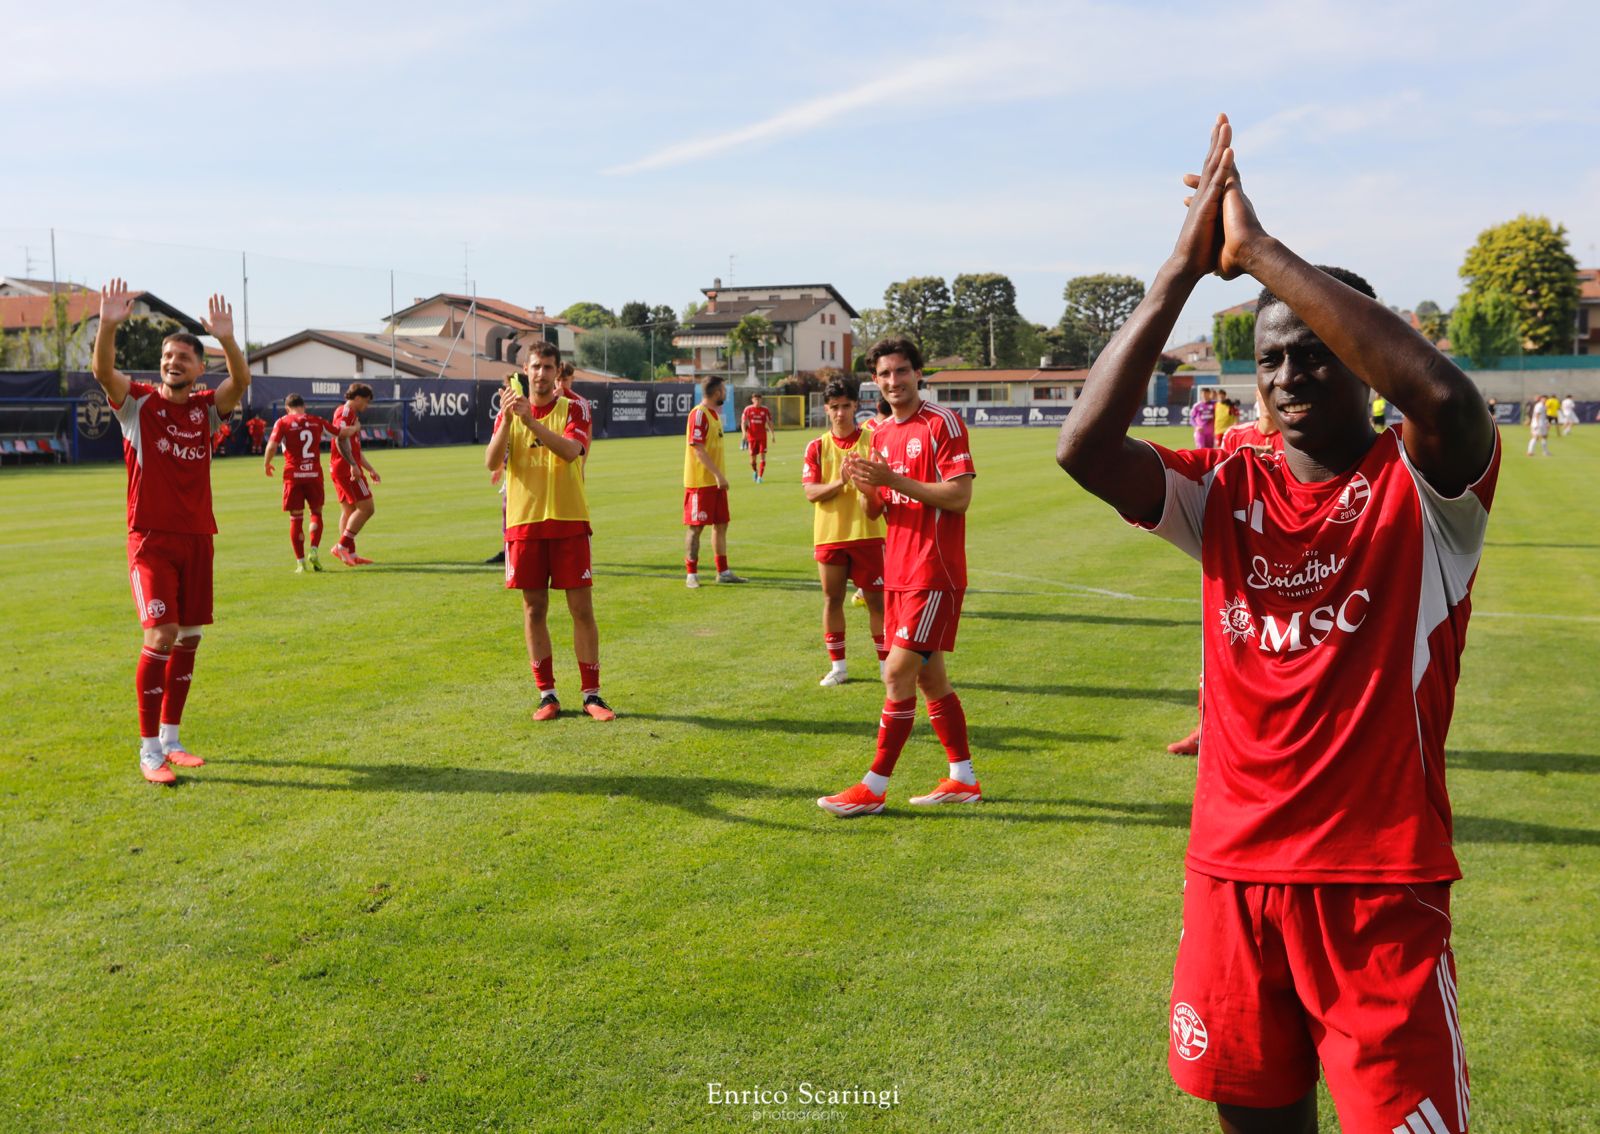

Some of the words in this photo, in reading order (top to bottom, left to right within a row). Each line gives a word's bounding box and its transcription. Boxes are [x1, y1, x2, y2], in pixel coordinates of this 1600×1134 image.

[430, 393, 469, 416] MSC
[1142, 407, 1169, 417] aro
[172, 443, 206, 460] MSC
[300, 429, 315, 458] 2
[891, 489, 920, 504] MS
[1340, 508, 1357, 520] 2010
[1258, 588, 1371, 653] MSC
